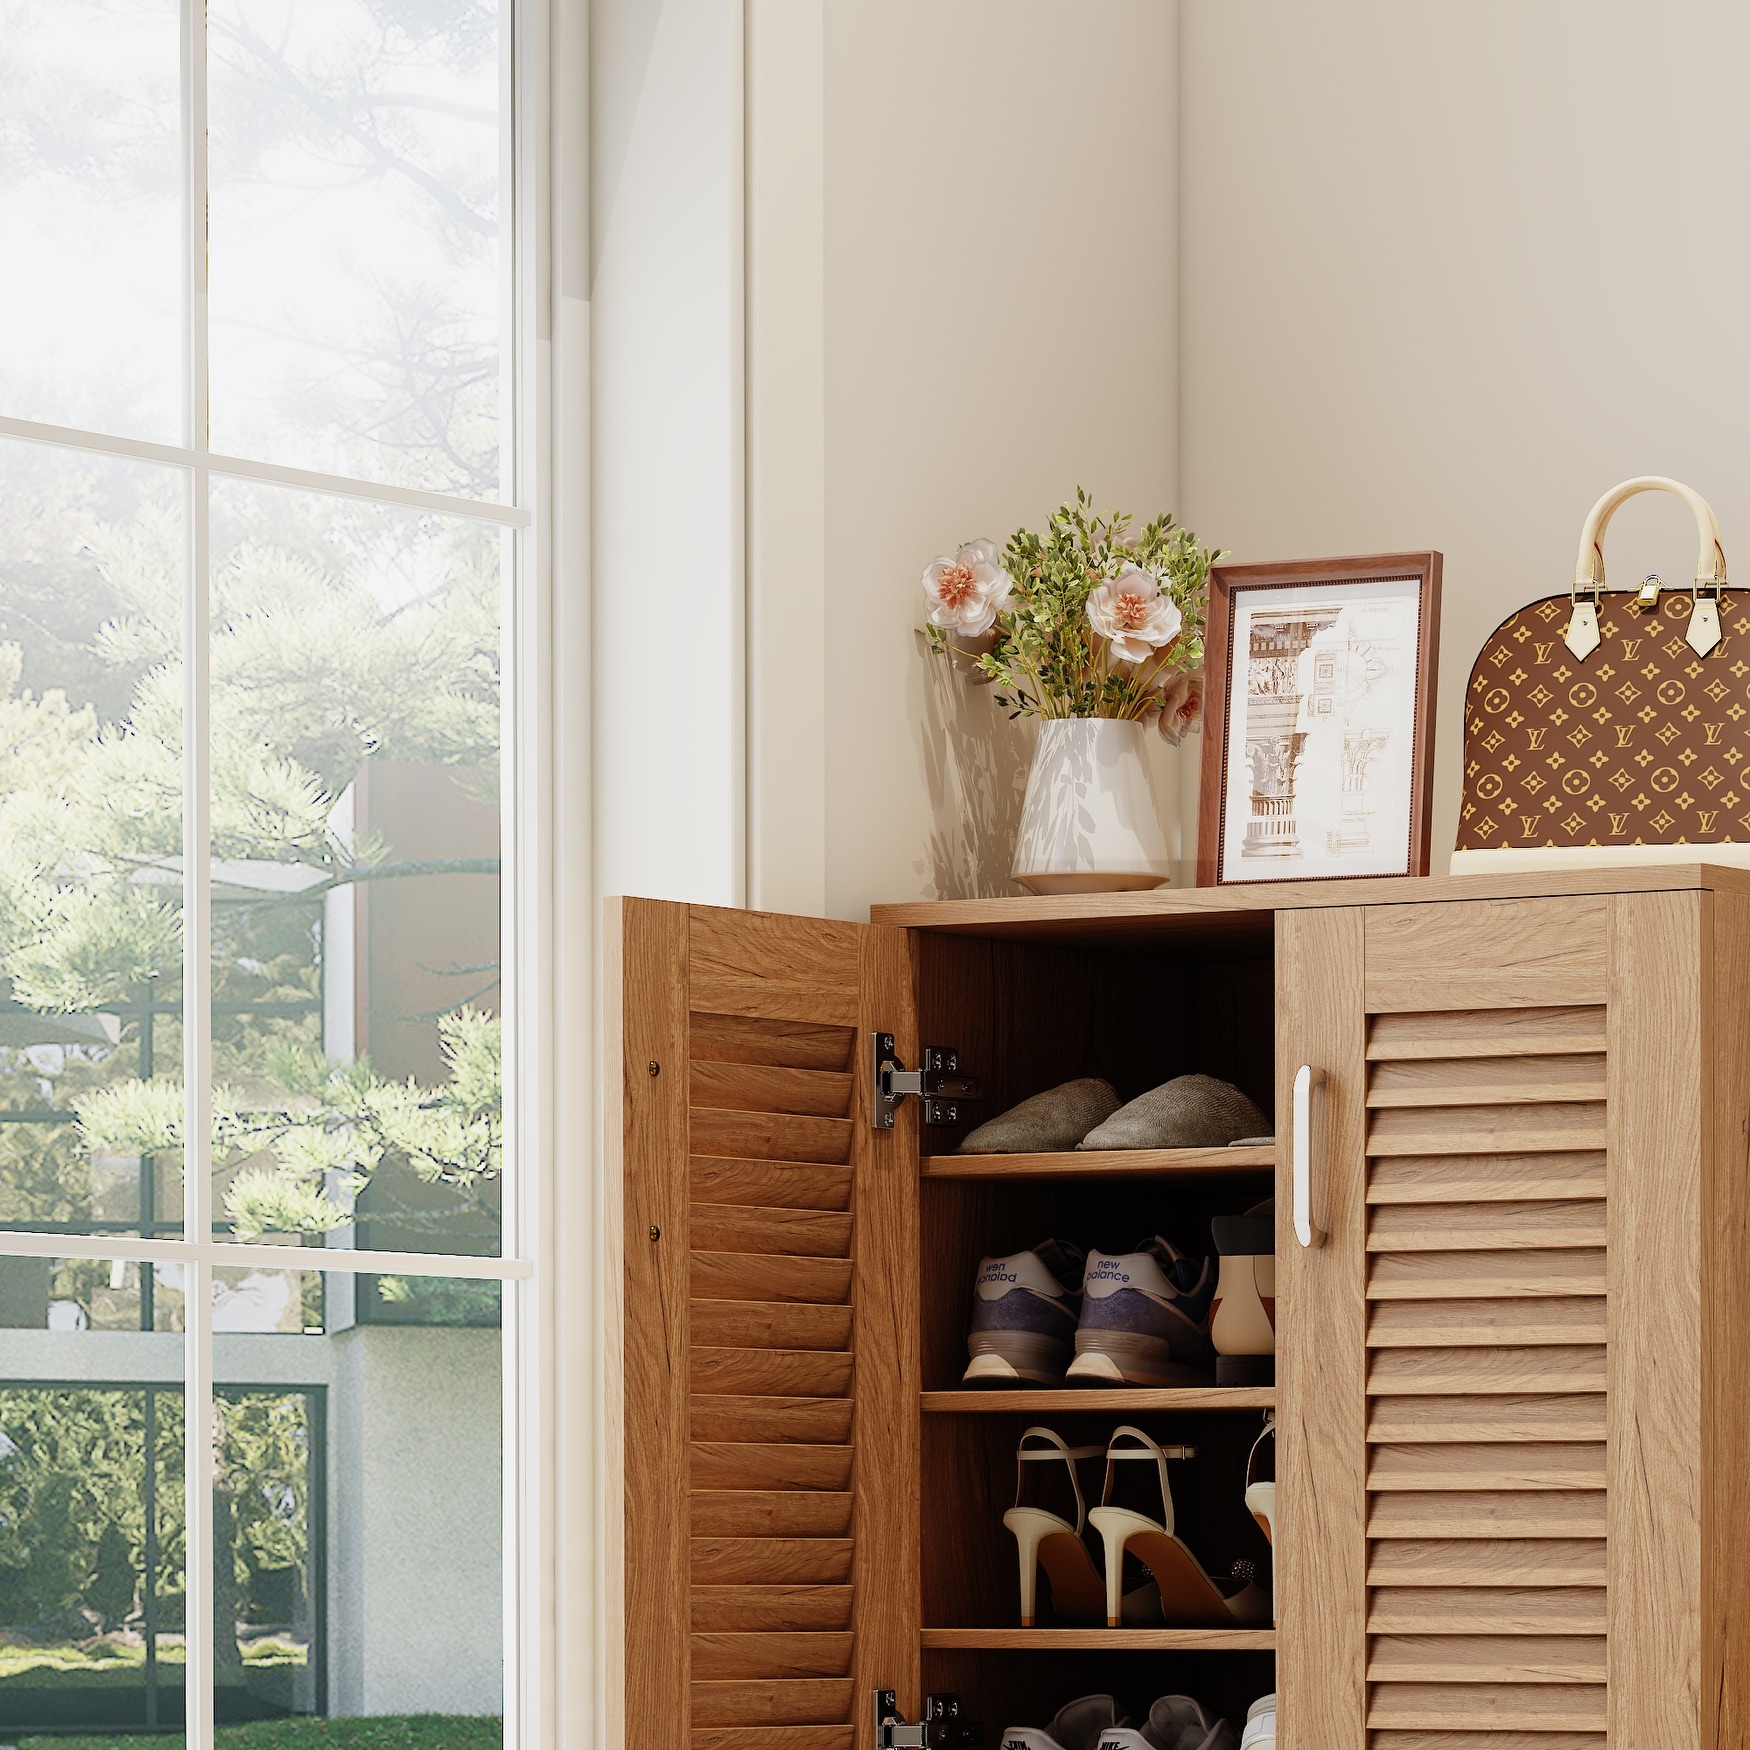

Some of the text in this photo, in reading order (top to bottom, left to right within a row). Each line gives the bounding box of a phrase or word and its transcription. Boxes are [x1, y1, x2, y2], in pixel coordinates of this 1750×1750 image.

[1533, 642, 1555, 664] LV
[1621, 639, 1643, 661] LV
[1526, 728, 1548, 750] LV
[1614, 725, 1636, 747] LV
[1703, 723, 1725, 745] LV
[1520, 815, 1541, 837] LV
[1608, 813, 1630, 835] LV
[1697, 811, 1719, 833] LV
[1097, 1260, 1120, 1269] new
